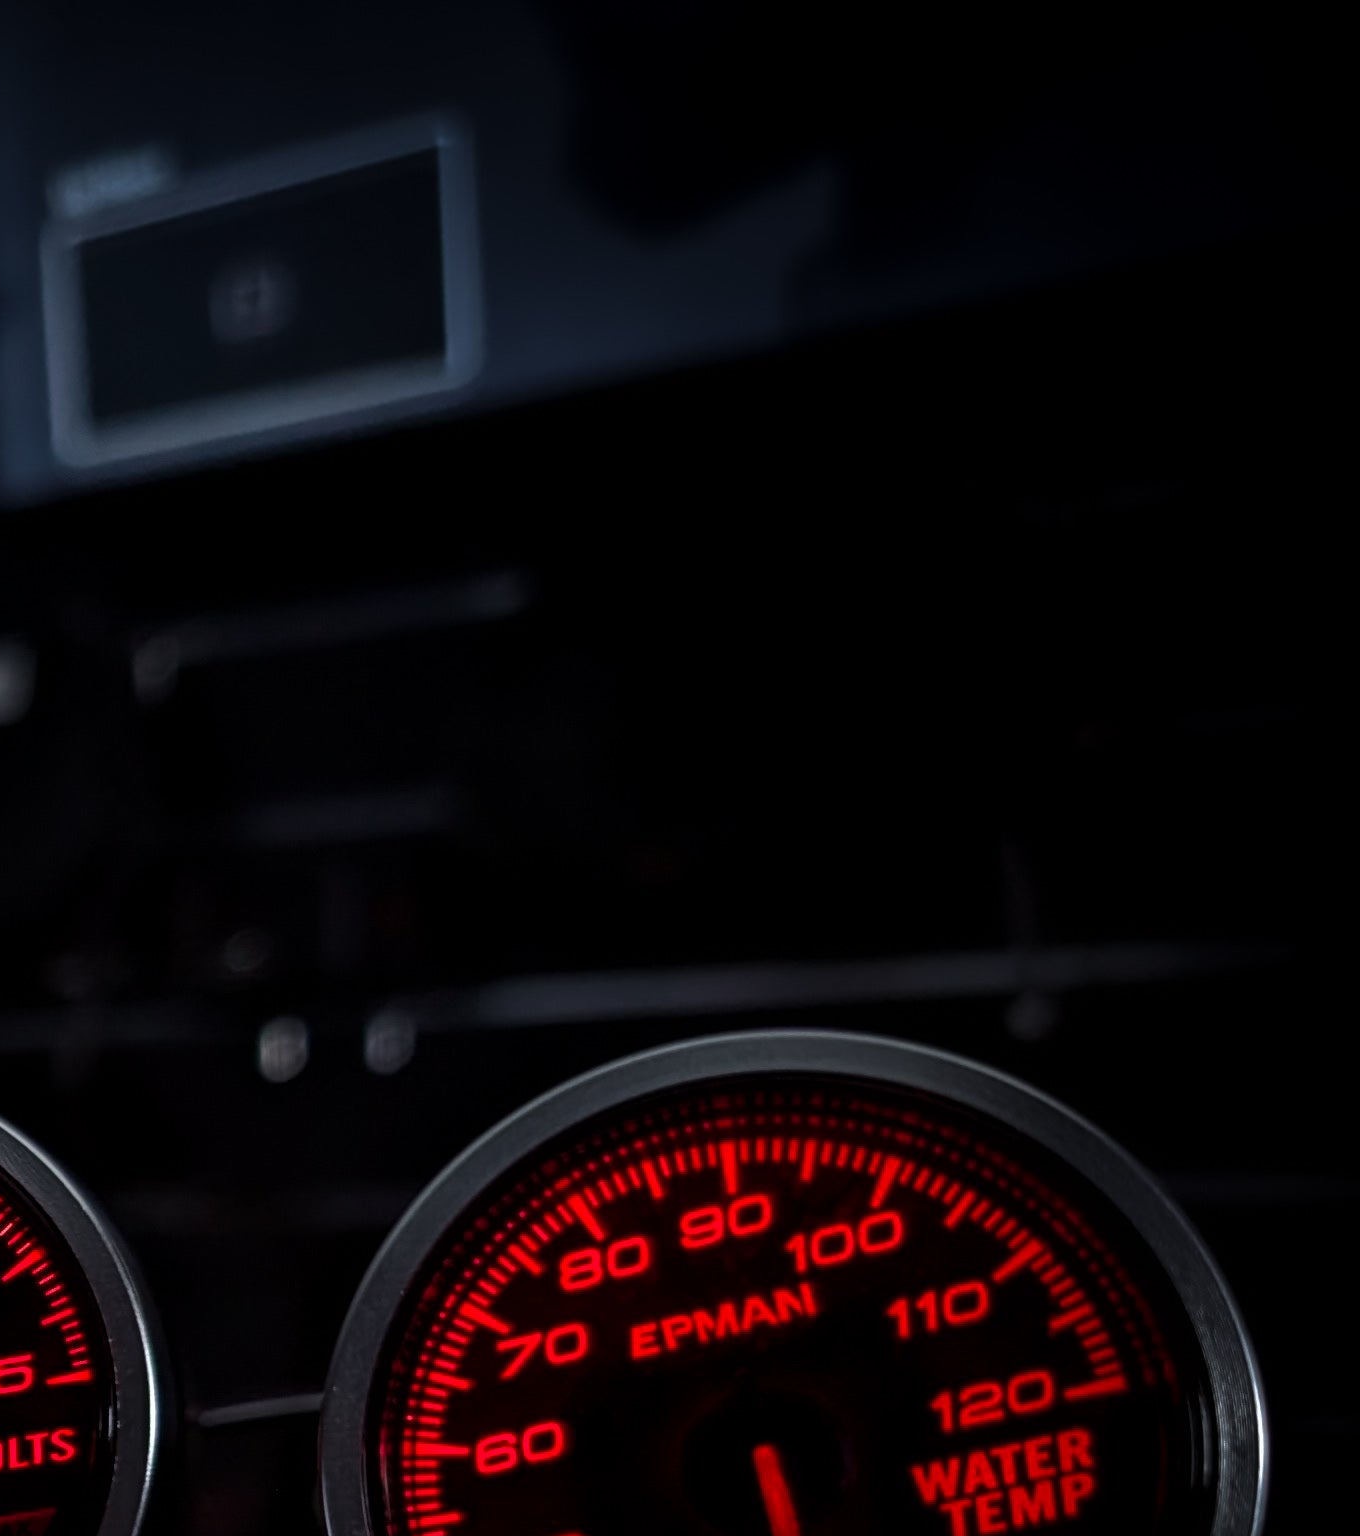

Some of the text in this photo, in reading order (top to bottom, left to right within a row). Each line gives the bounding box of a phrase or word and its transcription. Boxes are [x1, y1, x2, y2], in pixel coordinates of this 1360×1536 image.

[680, 1195, 774, 1251] 90
[783, 1210, 906, 1274] 100
[560, 1236, 653, 1291] 80
[628, 1282, 821, 1360] EPMAN
[884, 1280, 990, 1341] 110
[494, 1324, 590, 1382] 70
[929, 1369, 1056, 1435] 120
[473, 1422, 569, 1475] 60
[910, 1428, 1098, 1509] WATER
